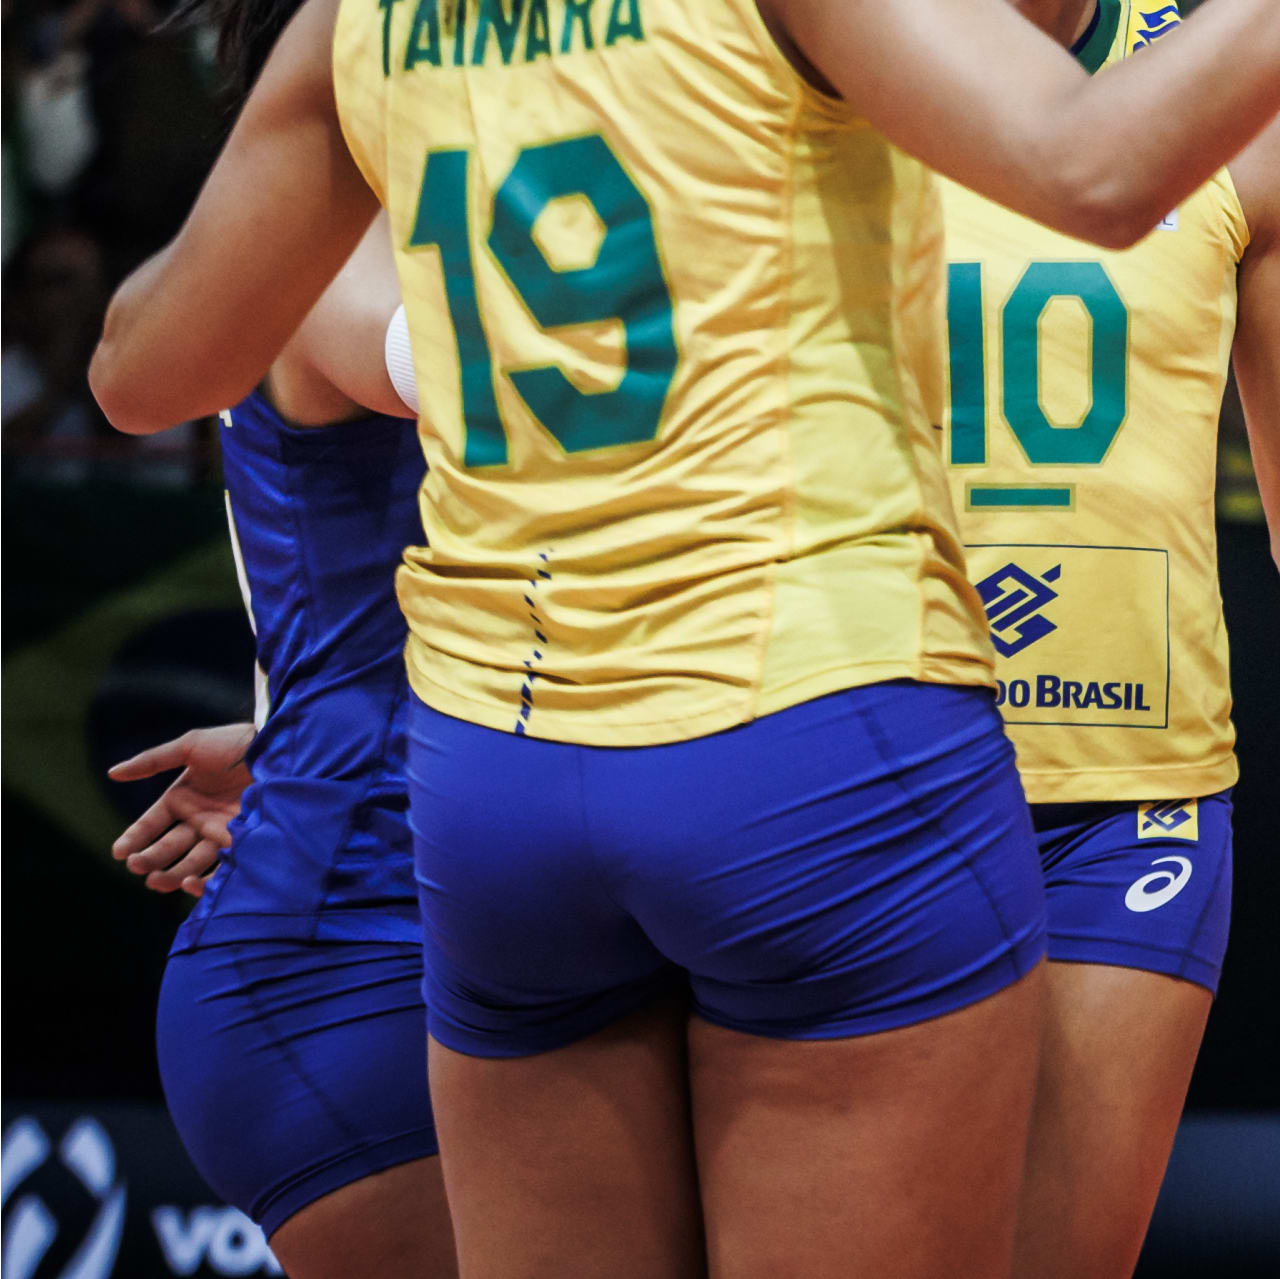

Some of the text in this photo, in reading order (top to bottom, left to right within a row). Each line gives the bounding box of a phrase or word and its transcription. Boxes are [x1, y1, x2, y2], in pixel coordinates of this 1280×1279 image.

[409, 133, 679, 468] 19
[946, 261, 1129, 466] 10
[1036, 674, 1151, 712] BRASIL
[151, 1204, 286, 1278] VO
